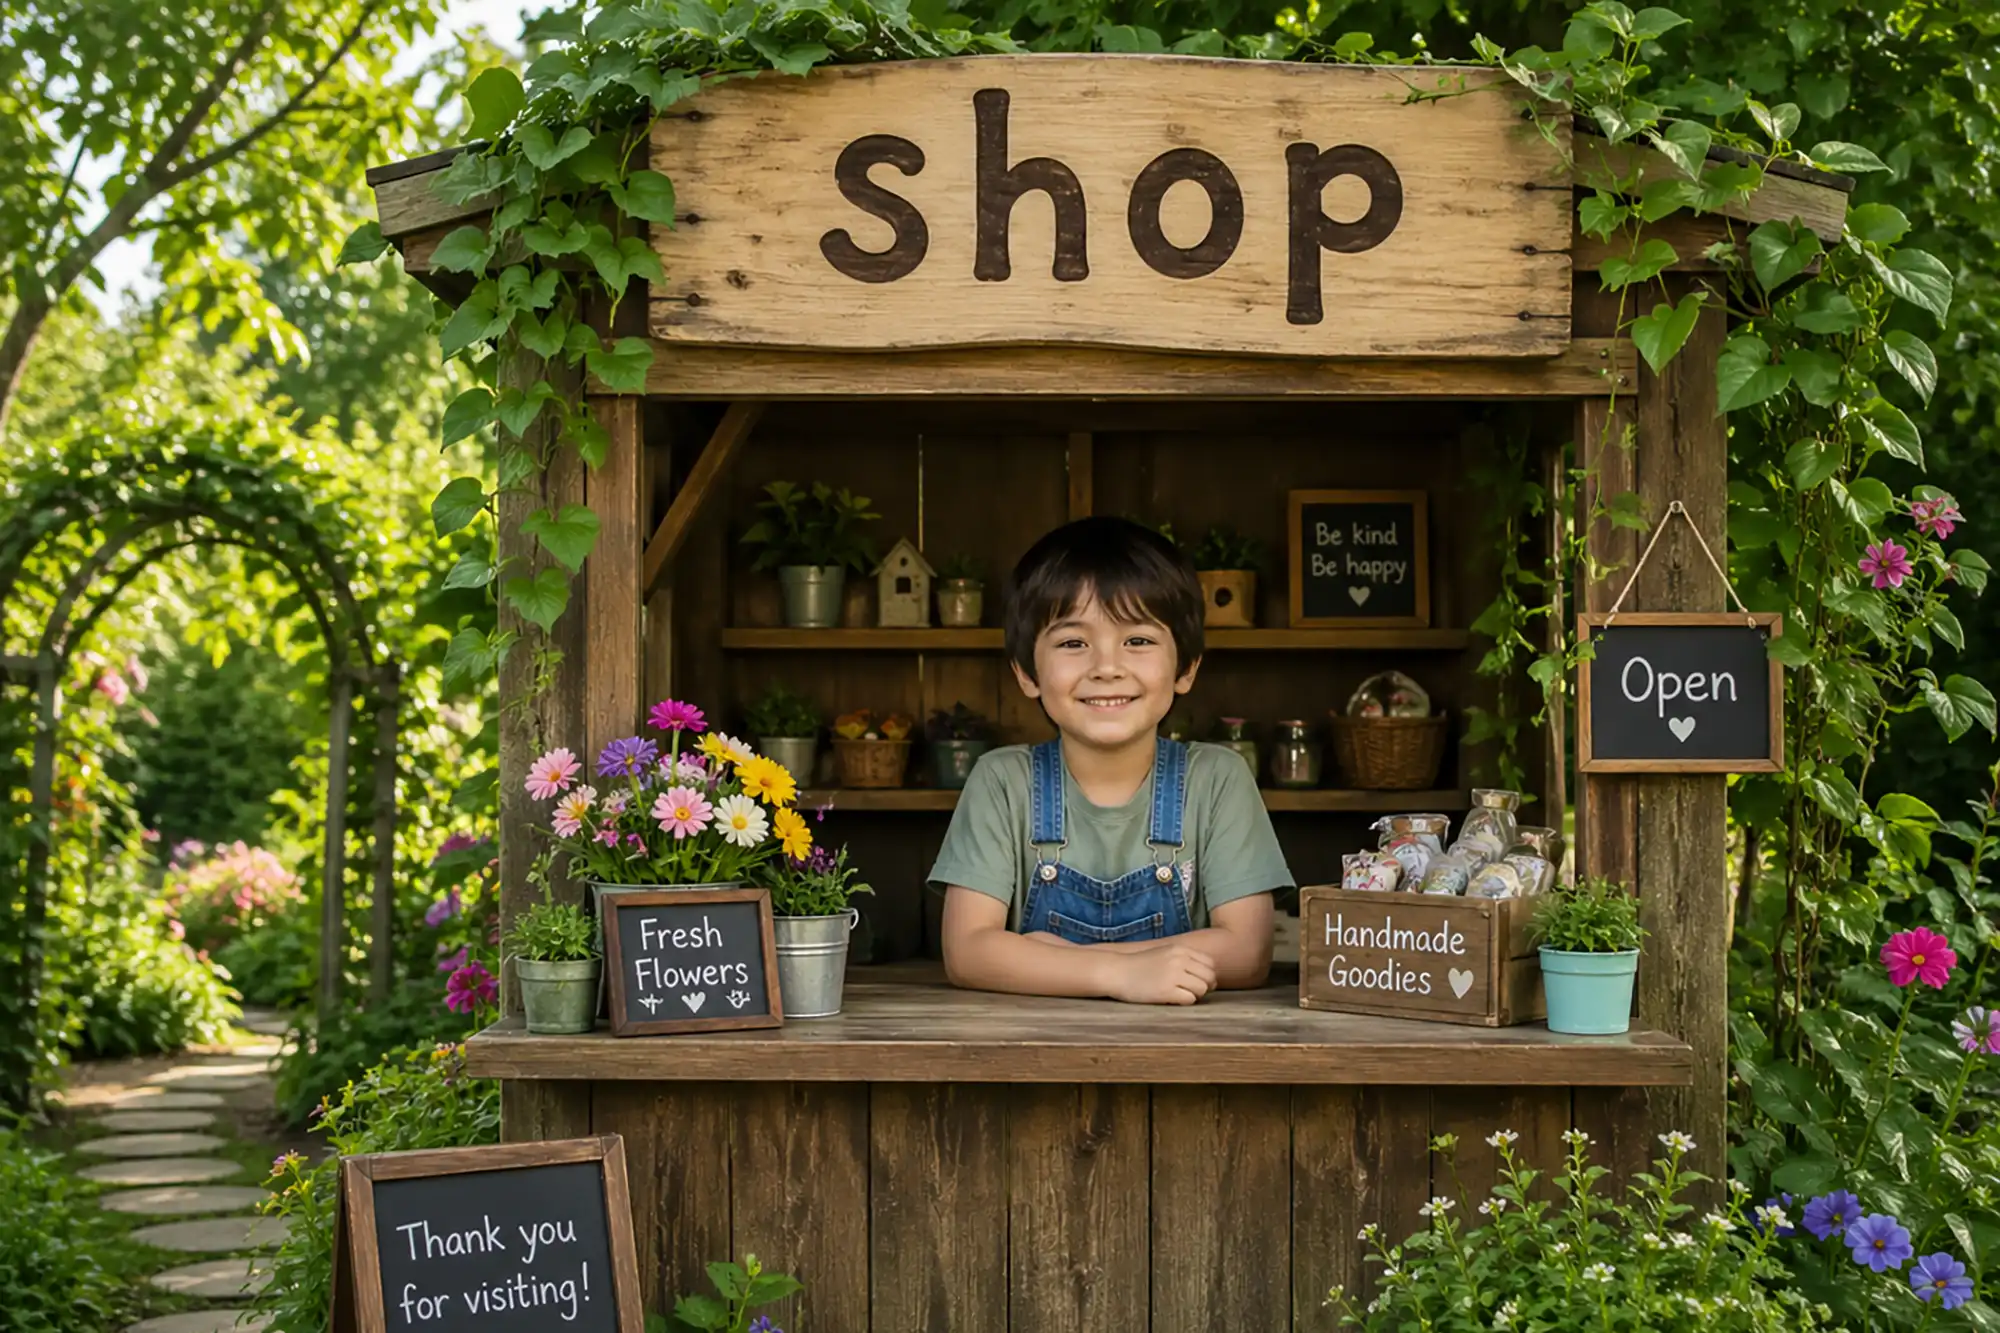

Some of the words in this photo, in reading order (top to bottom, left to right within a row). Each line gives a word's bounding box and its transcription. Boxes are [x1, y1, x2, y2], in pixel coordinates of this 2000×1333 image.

[819, 87, 1404, 325] shop
[1316, 521, 1342, 546] Be
[1352, 521, 1398, 546] kind
[1311, 553, 1337, 577] Be
[1346, 552, 1406, 584] happy
[1621, 656, 1738, 718] Open
[640, 915, 723, 950] Fresh
[1324, 913, 1466, 955] Handmade
[635, 957, 749, 991] Flowers
[1328, 954, 1432, 995] Goodies
[396, 1214, 506, 1260] Thank
[518, 1219, 577, 1264] you
[399, 1283, 450, 1323] for
[463, 1261, 590, 1321] visiting!
